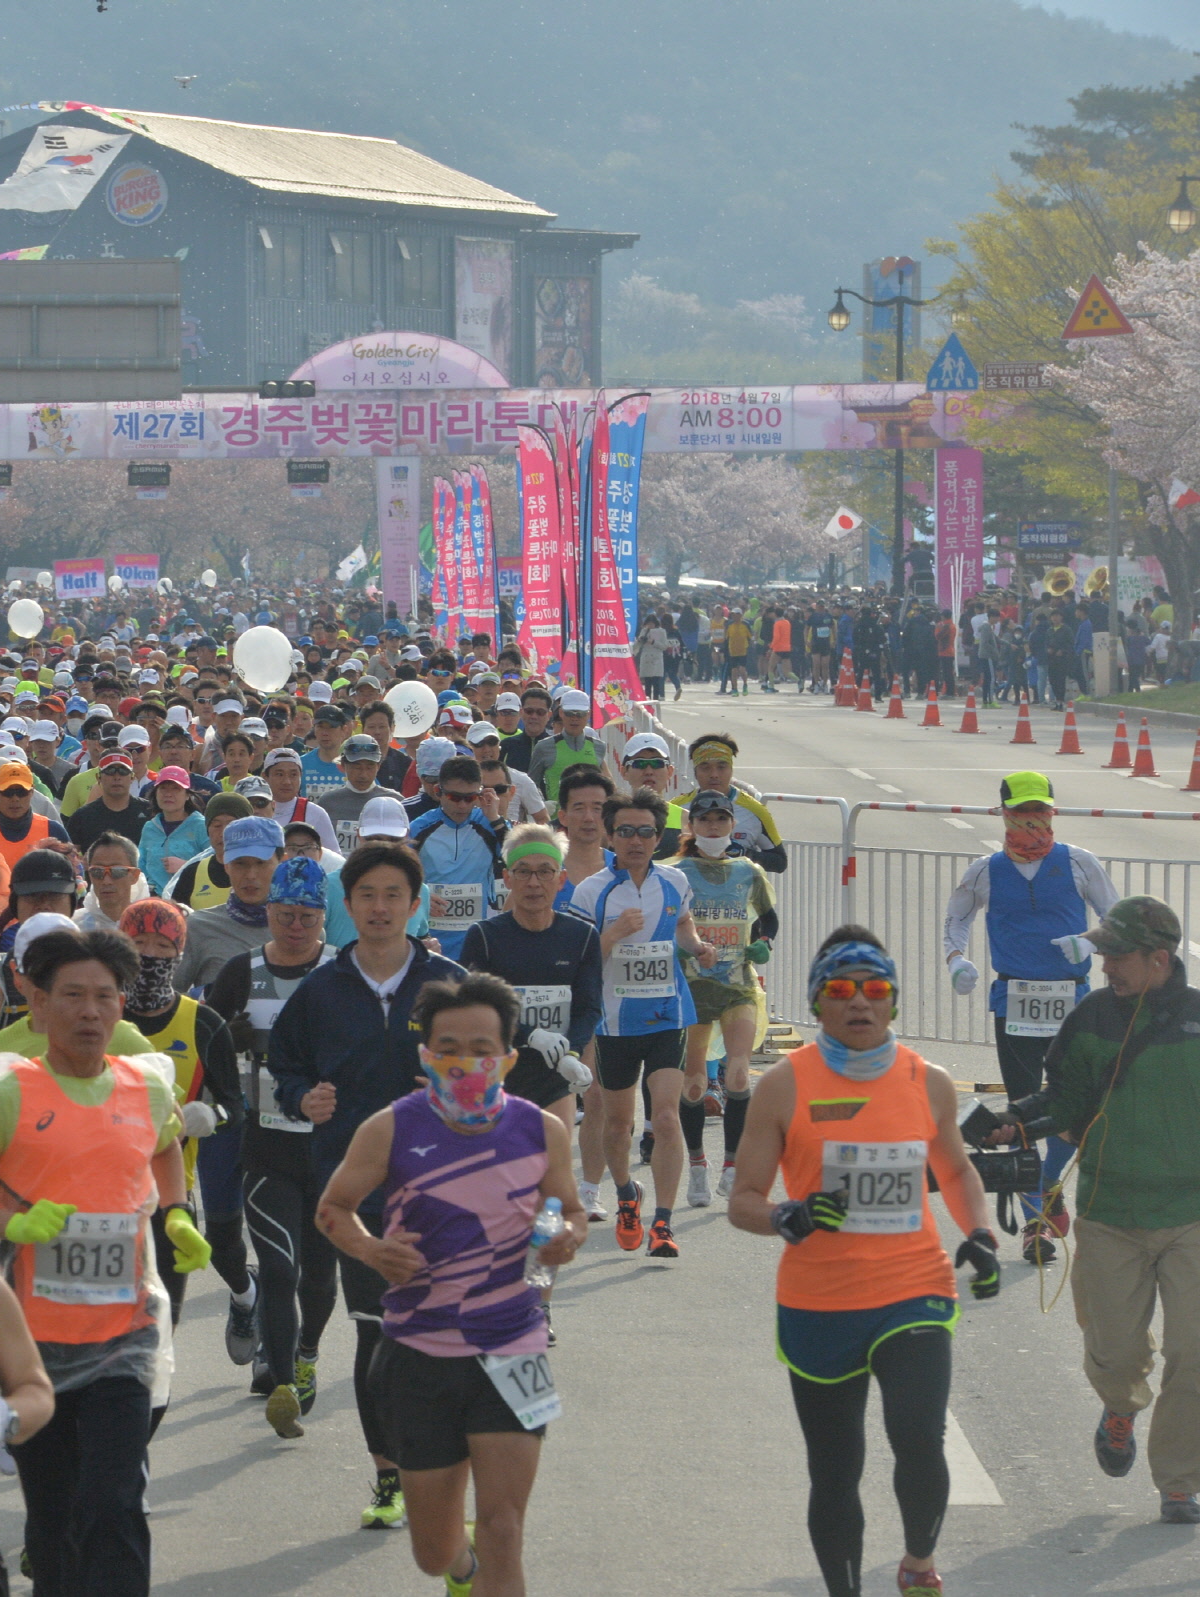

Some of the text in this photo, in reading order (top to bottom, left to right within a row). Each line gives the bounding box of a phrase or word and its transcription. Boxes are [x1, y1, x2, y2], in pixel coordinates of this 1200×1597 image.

[114, 175, 159, 198] BURGER
[116, 186, 161, 212] KING
[352, 343, 440, 364] Golden City
[342, 371, 450, 386] 어서오십시오
[680, 392, 781, 405] 2018년 4월 7일
[112, 411, 204, 440] 제27회
[679, 407, 782, 428] AM 8:00
[679, 434, 721, 446] 보문단지
[741, 432, 782, 445] 시내일원
[62, 572, 98, 590] Half
[501, 568, 523, 586] 5k
[596, 609, 617, 621] 2018.
[403, 704, 420, 725] 3:40
[411, 700, 425, 720] FULL
[622, 959, 668, 982] 1343
[1018, 997, 1066, 1021] 1618
[839, 1171, 913, 1206] 1025
[51, 1242, 125, 1279] 1613
